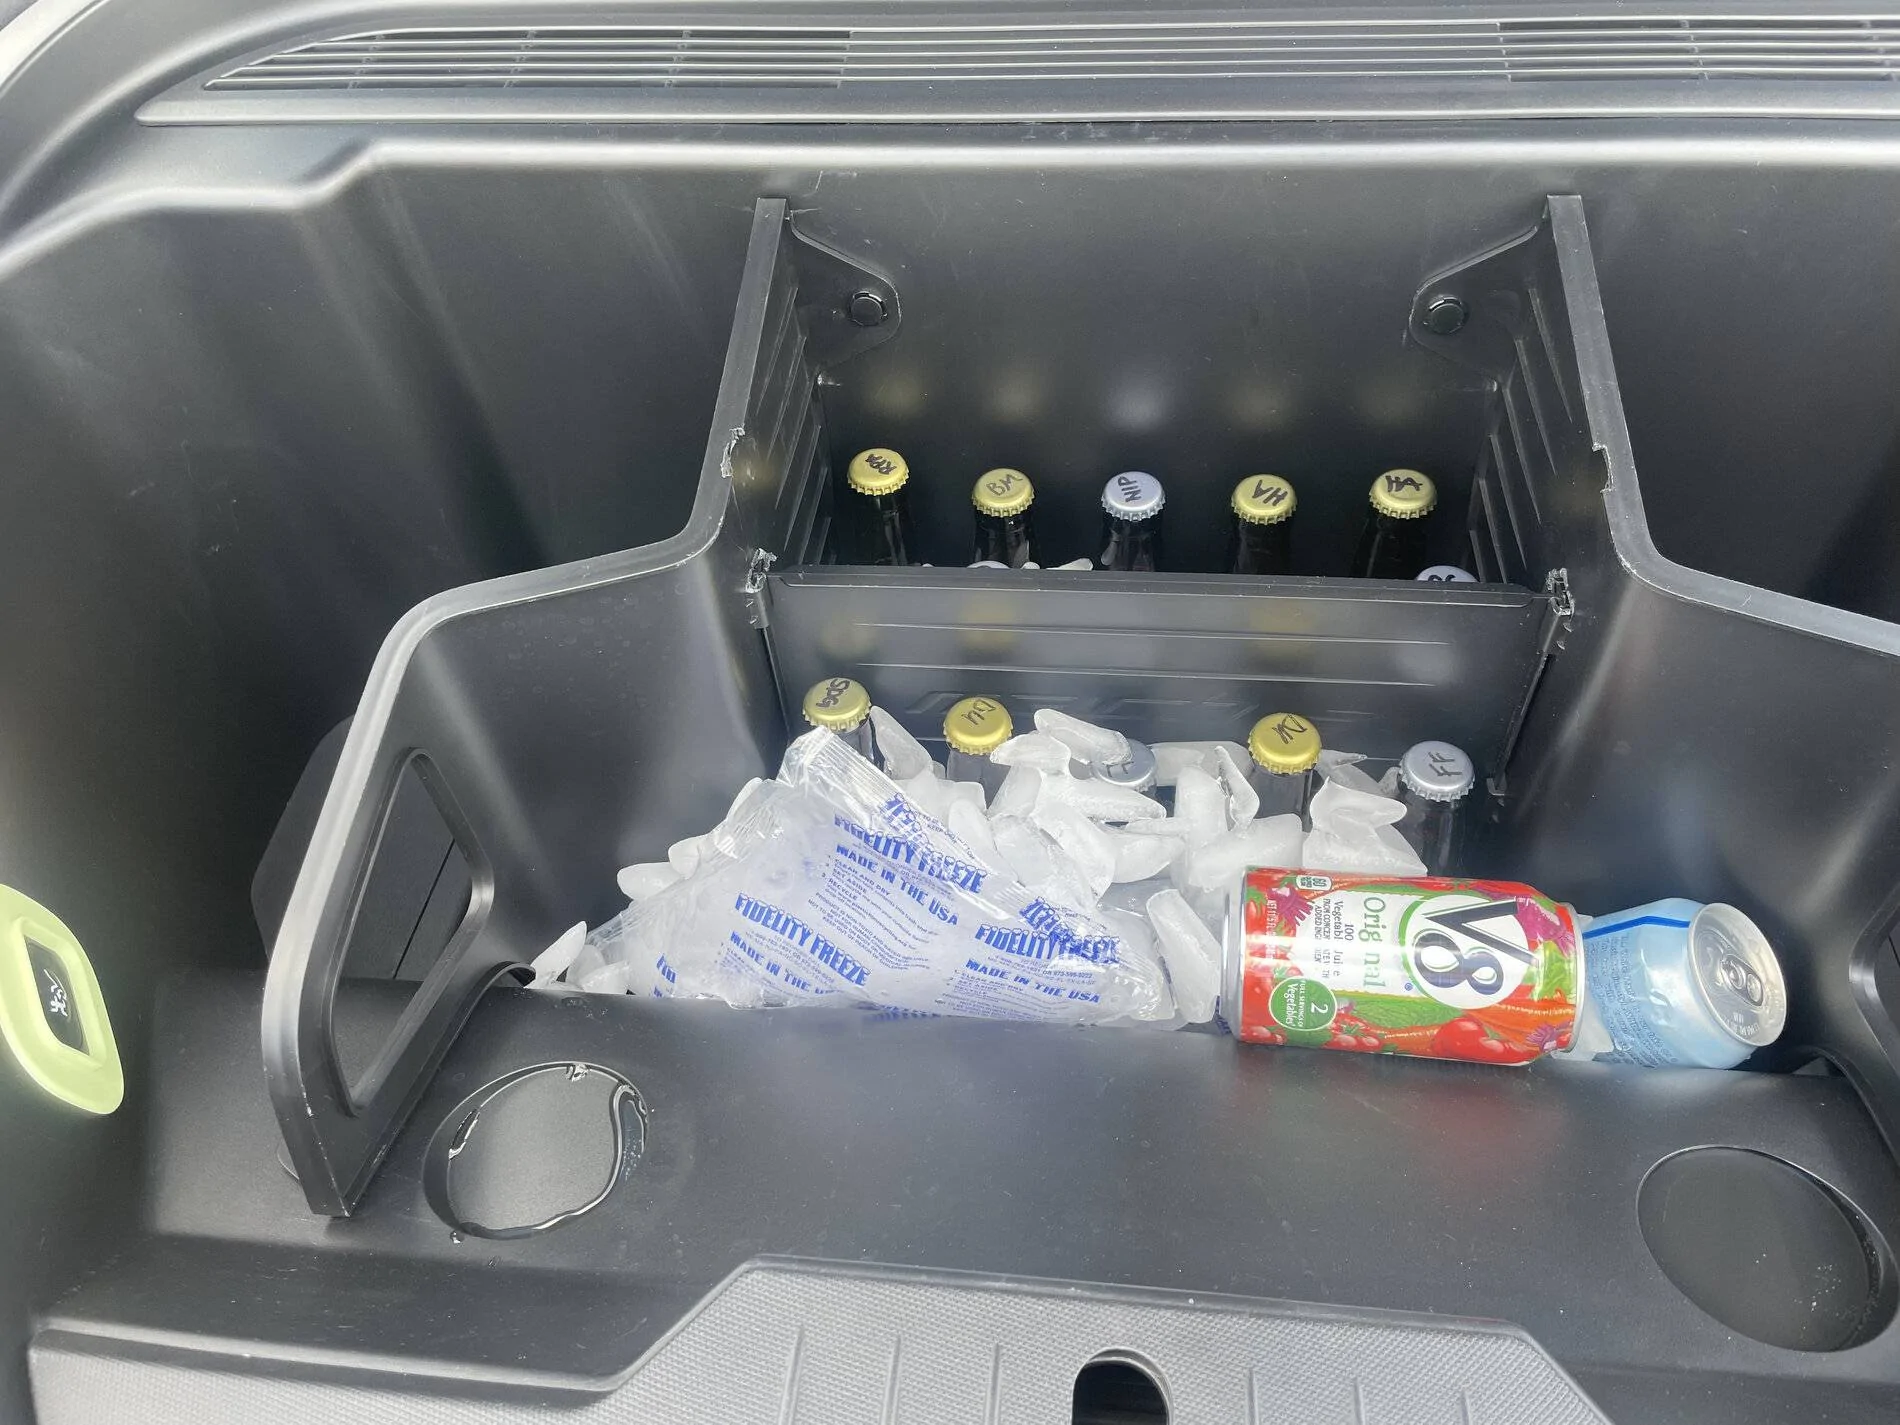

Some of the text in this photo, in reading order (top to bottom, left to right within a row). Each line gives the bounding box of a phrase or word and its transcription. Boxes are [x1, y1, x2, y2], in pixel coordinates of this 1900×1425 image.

[836, 844, 878, 873] MADE
[881, 866, 896, 884] IN
[900, 874, 927, 905] THE
[928, 899, 958, 926] USA
[730, 930, 763, 966] MADE
[766, 960, 782, 977] IN
[783, 968, 811, 992] THE
[735, 892, 814, 947] FIDELITY
[810, 931, 872, 987] FREEZE
[975, 923, 1059, 960] FIDELITY
[1322, 914, 1331, 959] CONCENATE
[1332, 900, 1343, 976] Vegetabl Juie
[1358, 896, 1387, 987] Orignal
[1414, 898, 1541, 996] V8
[965, 959, 1007, 977] MADE
[1013, 974, 1031, 986] IN
[1034, 981, 1063, 996] THE
[1068, 990, 1100, 1003] USA
[1283, 983, 1299, 1027] Vegetables
[1310, 1001, 1329, 1014] 2
